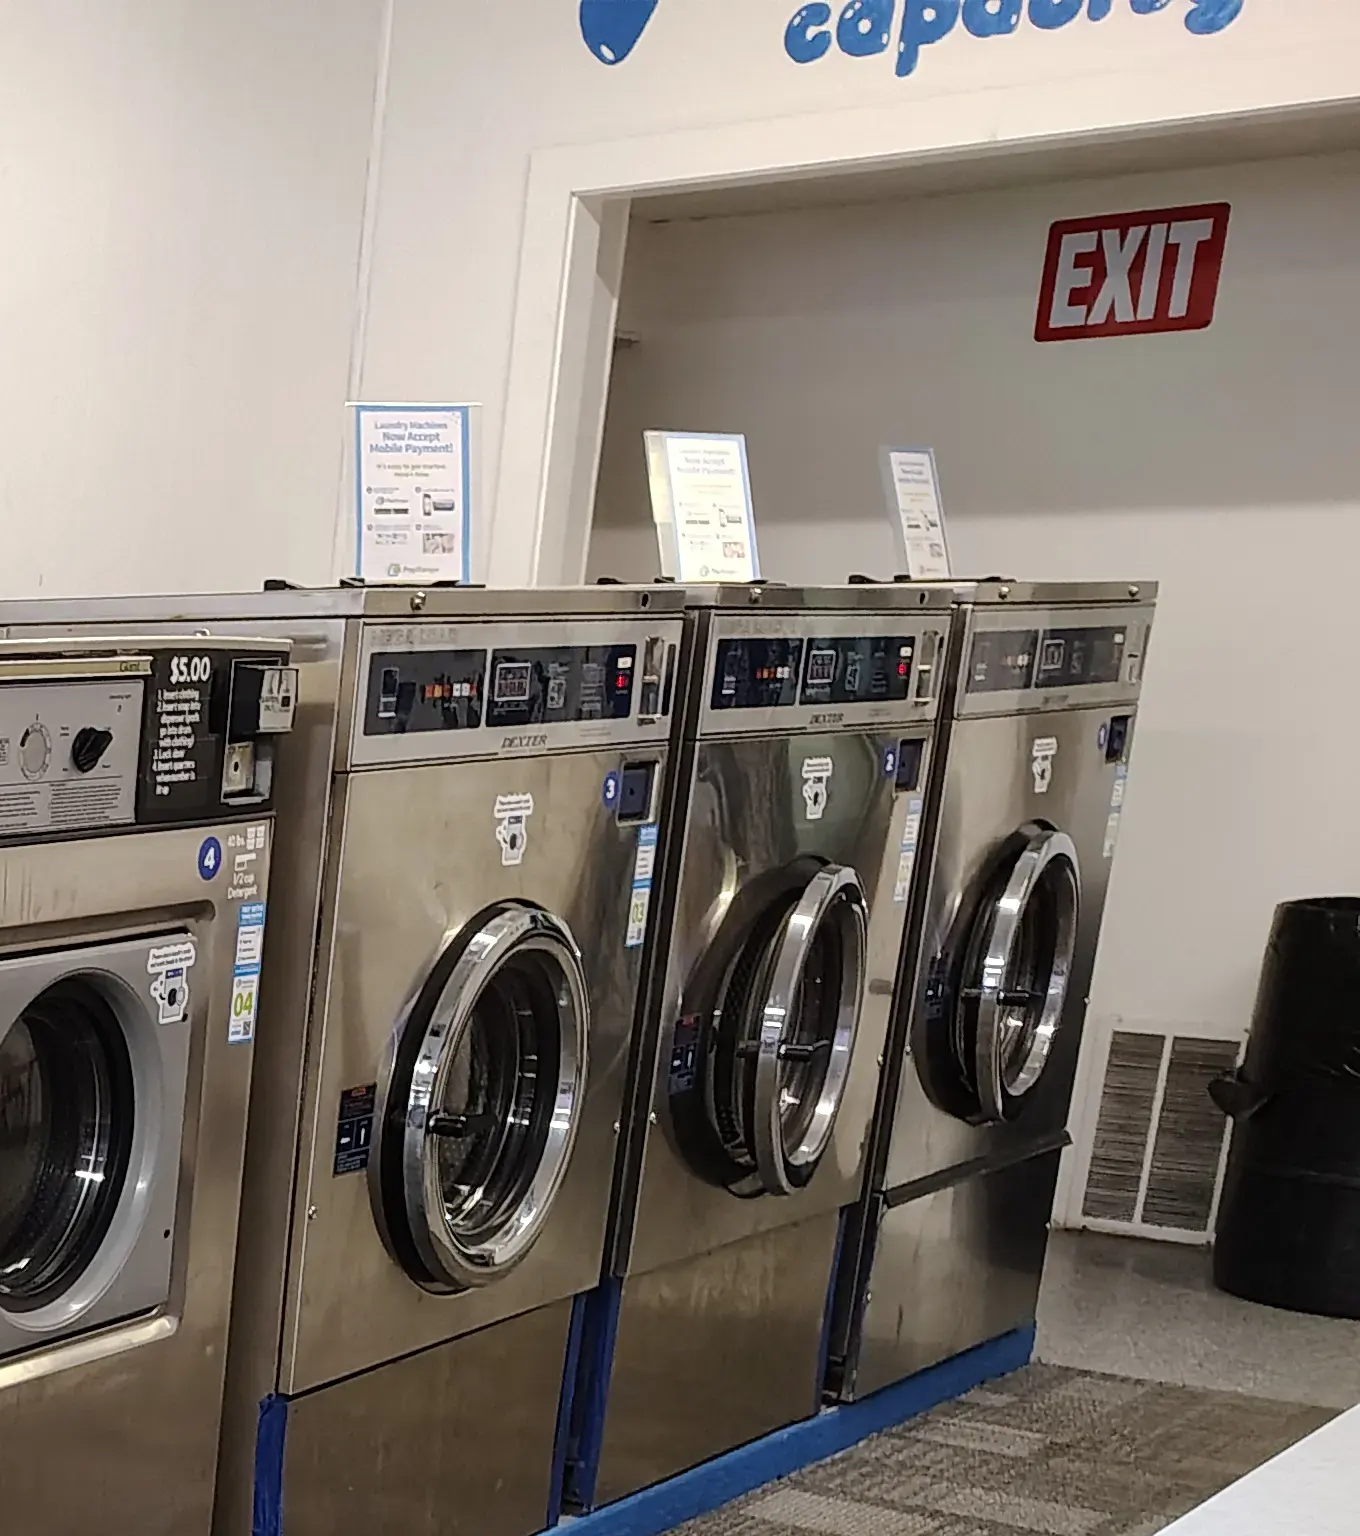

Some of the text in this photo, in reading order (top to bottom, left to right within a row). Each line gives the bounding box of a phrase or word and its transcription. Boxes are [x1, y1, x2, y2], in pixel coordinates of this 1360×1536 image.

[1048, 219, 1215, 330] EXIT
[382, 431, 441, 443] Now Accept
[369, 442, 454, 456] Mobile Payment!
[169, 655, 211, 685] $5.00
[501, 733, 548, 749] DEXTER
[885, 753, 894, 772] 2
[605, 778, 616, 799] 3
[204, 847, 216, 870] 4
[234, 991, 254, 1018] 04
